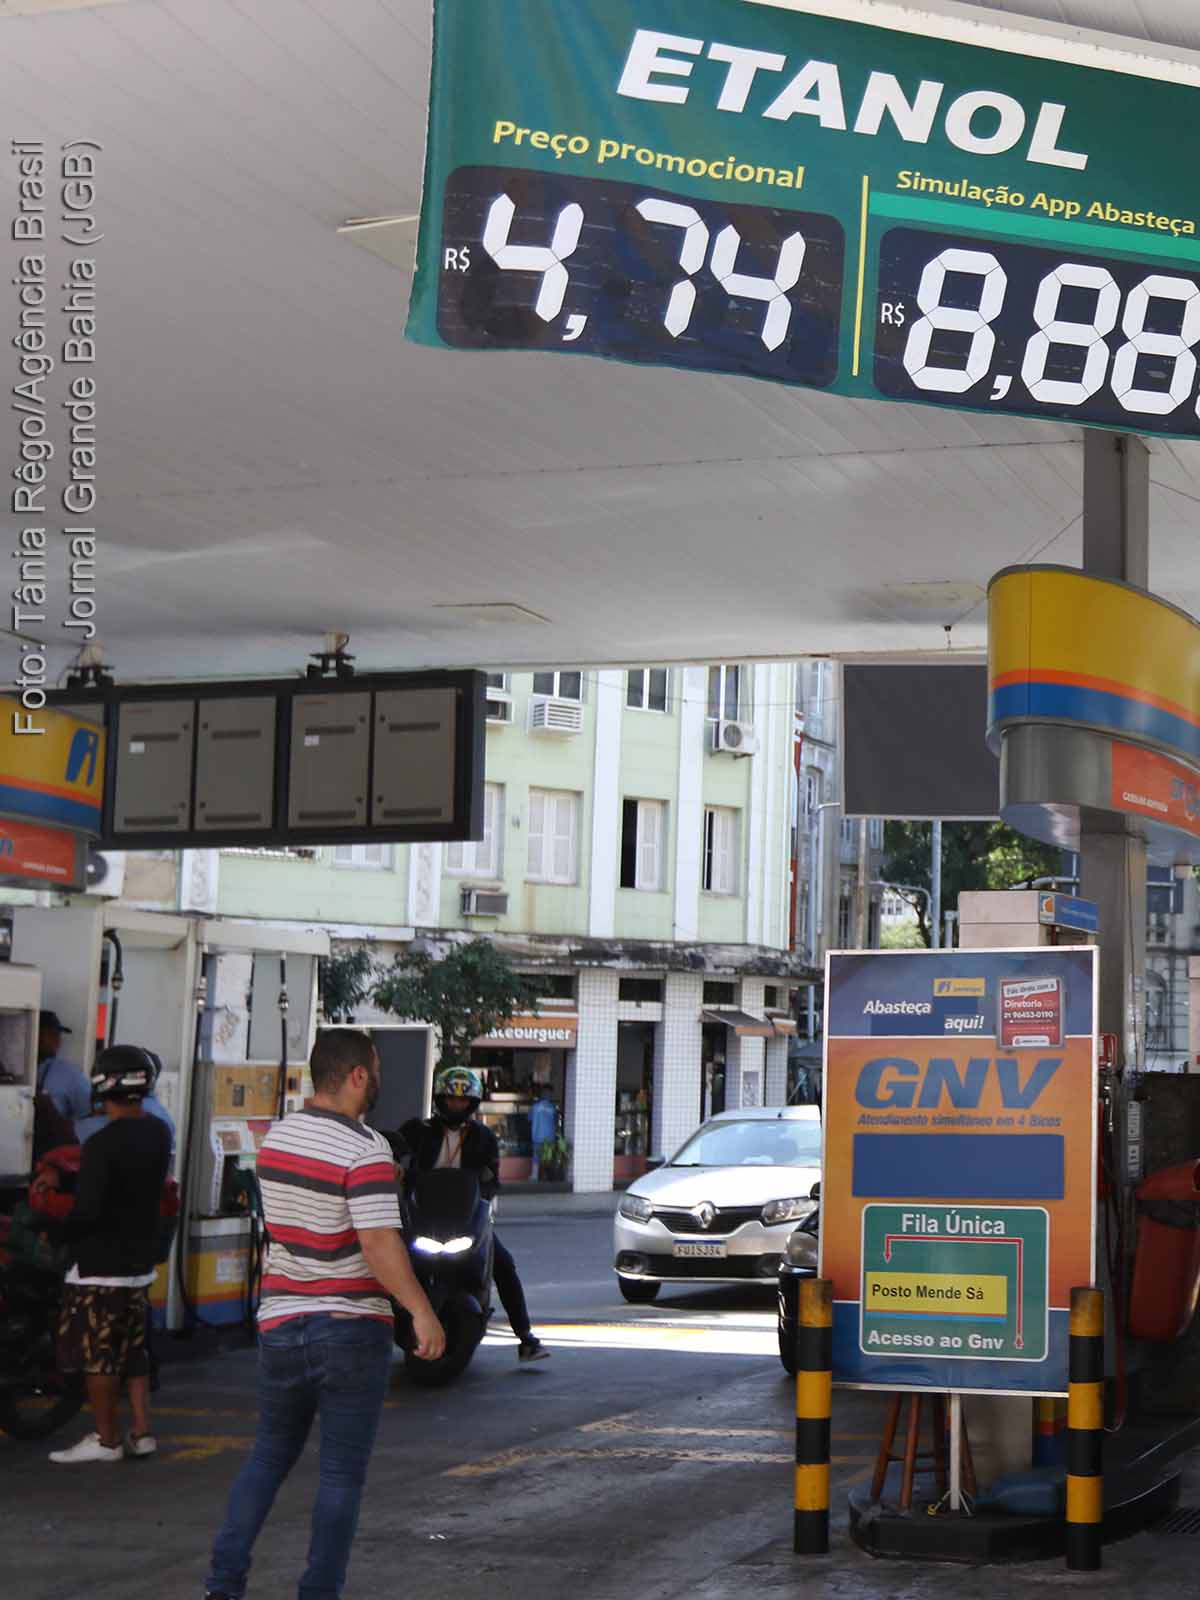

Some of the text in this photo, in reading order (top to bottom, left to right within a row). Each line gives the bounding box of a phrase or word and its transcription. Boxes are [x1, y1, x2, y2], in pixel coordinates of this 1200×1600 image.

[616, 29, 1089, 171] ETANOL
[492, 120, 805, 189] Preço promocional
[896, 170, 1025, 208] Simulação
[1031, 192, 1081, 219] App
[1086, 201, 1195, 241] Abasteça
[444, 193, 806, 352] R$ 4,74
[880, 302, 905, 327] R$
[863, 1000, 932, 1015] Abasteça
[1004, 999, 1042, 1008] Diretoria
[944, 1015, 984, 1032] aqui!
[855, 1057, 1062, 1109] GNV
[901, 1210, 1005, 1235] Fila Única
[872, 1284, 984, 1300] Posto Mende Sá
[867, 1330, 1005, 1349] Acesso ao Gnv
